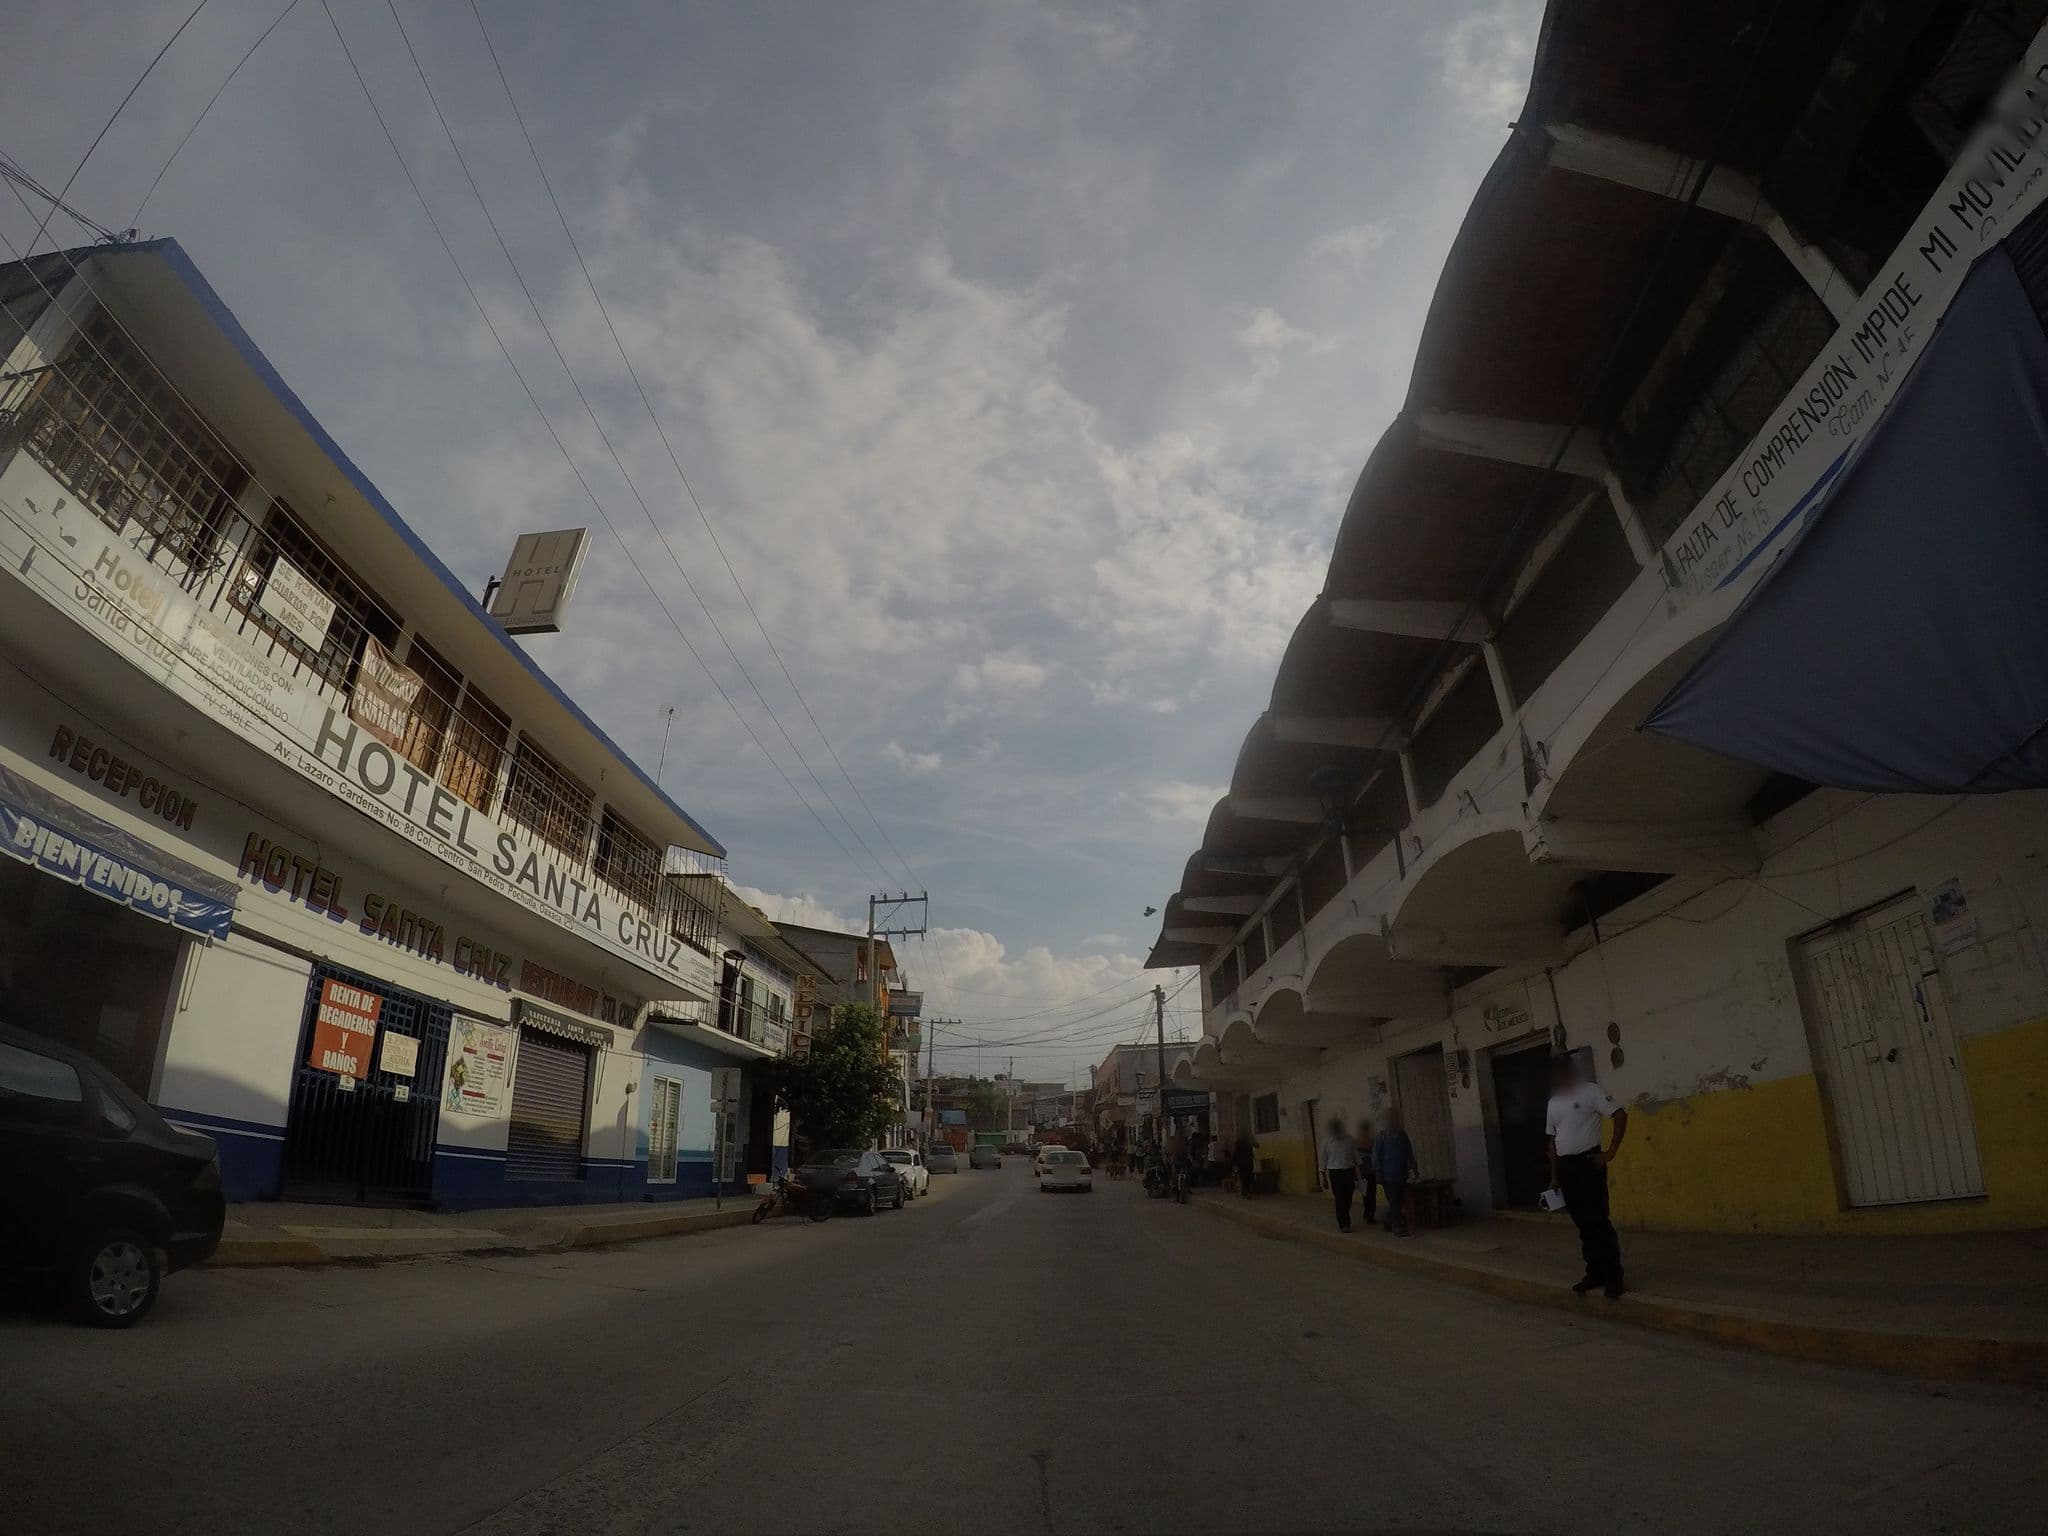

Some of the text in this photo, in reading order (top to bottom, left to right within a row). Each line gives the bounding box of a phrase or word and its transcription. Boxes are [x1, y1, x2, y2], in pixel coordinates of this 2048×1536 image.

[1676, 522, 1719, 575] FALTA
[1715, 490, 1743, 528] DE
[1743, 354, 1858, 498] COMPRENSIÓN
[1850, 272, 1923, 364] IMPIDE
[1919, 225, 1958, 273] MI
[278, 562, 292, 581] SE
[513, 566, 560, 577] HOTEL
[75, 569, 130, 632] Santa
[279, 607, 304, 633] MES
[309, 610, 328, 630] POR
[183, 642, 289, 724] AIRE ACONDICIONADO
[213, 644, 274, 696] VENTILADOR
[271, 672, 295, 696] CON:
[219, 703, 252, 733] CABLE
[49, 724, 200, 832] RECEPCION
[273, 741, 292, 762] Av.
[297, 755, 333, 787] Lazaro
[338, 782, 384, 819] Cardenas
[403, 823, 416, 838] 88
[437, 843, 464, 867] Centro
[467, 861, 483, 878] San
[484, 870, 505, 891] Pedro
[313, 707, 477, 858] HOTEL
[493, 832, 602, 931] SANTA
[618, 911, 682, 972] CRUZ
[13, 815, 184, 915] BIENVENIDOS
[237, 831, 348, 924] HOTEL
[359, 893, 444, 966] SANTA
[453, 935, 513, 993] CRUZ
[329, 983, 375, 1014] RENTA DE
[319, 1003, 376, 1036] REGADERAS
[341, 1031, 349, 1049] Y
[322, 1049, 358, 1074] BAÑOS
